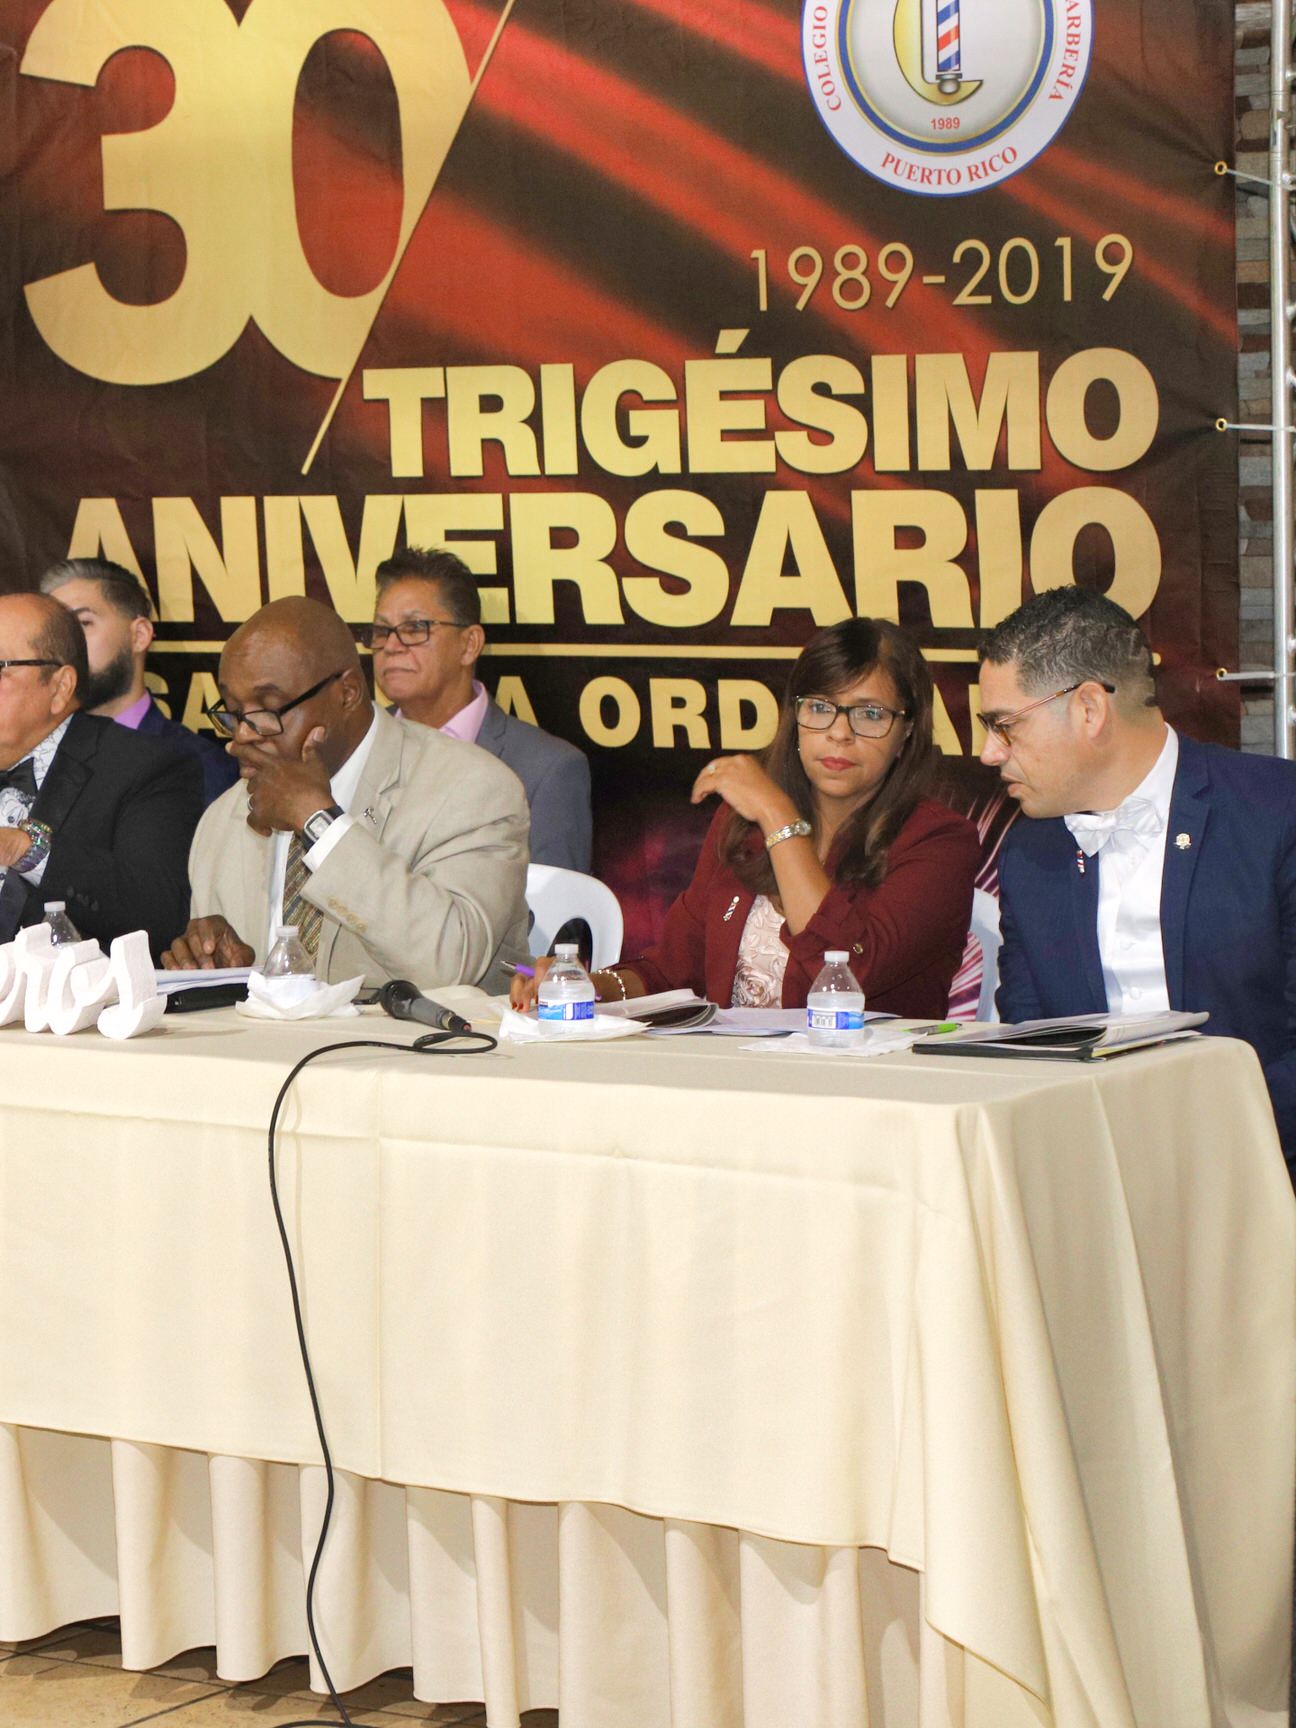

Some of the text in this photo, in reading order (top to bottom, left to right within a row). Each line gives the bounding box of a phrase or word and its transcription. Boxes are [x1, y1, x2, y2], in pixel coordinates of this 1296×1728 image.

[811, 5, 842, 112] COLEGIO
[880, 145, 1018, 186] PUERTO RICO
[930, 117, 961, 131] 1989
[19, 0, 473, 386] 30
[750, 234, 1133, 312] 1989-2019
[363, 329, 1159, 478] TRIGÉSIMO
